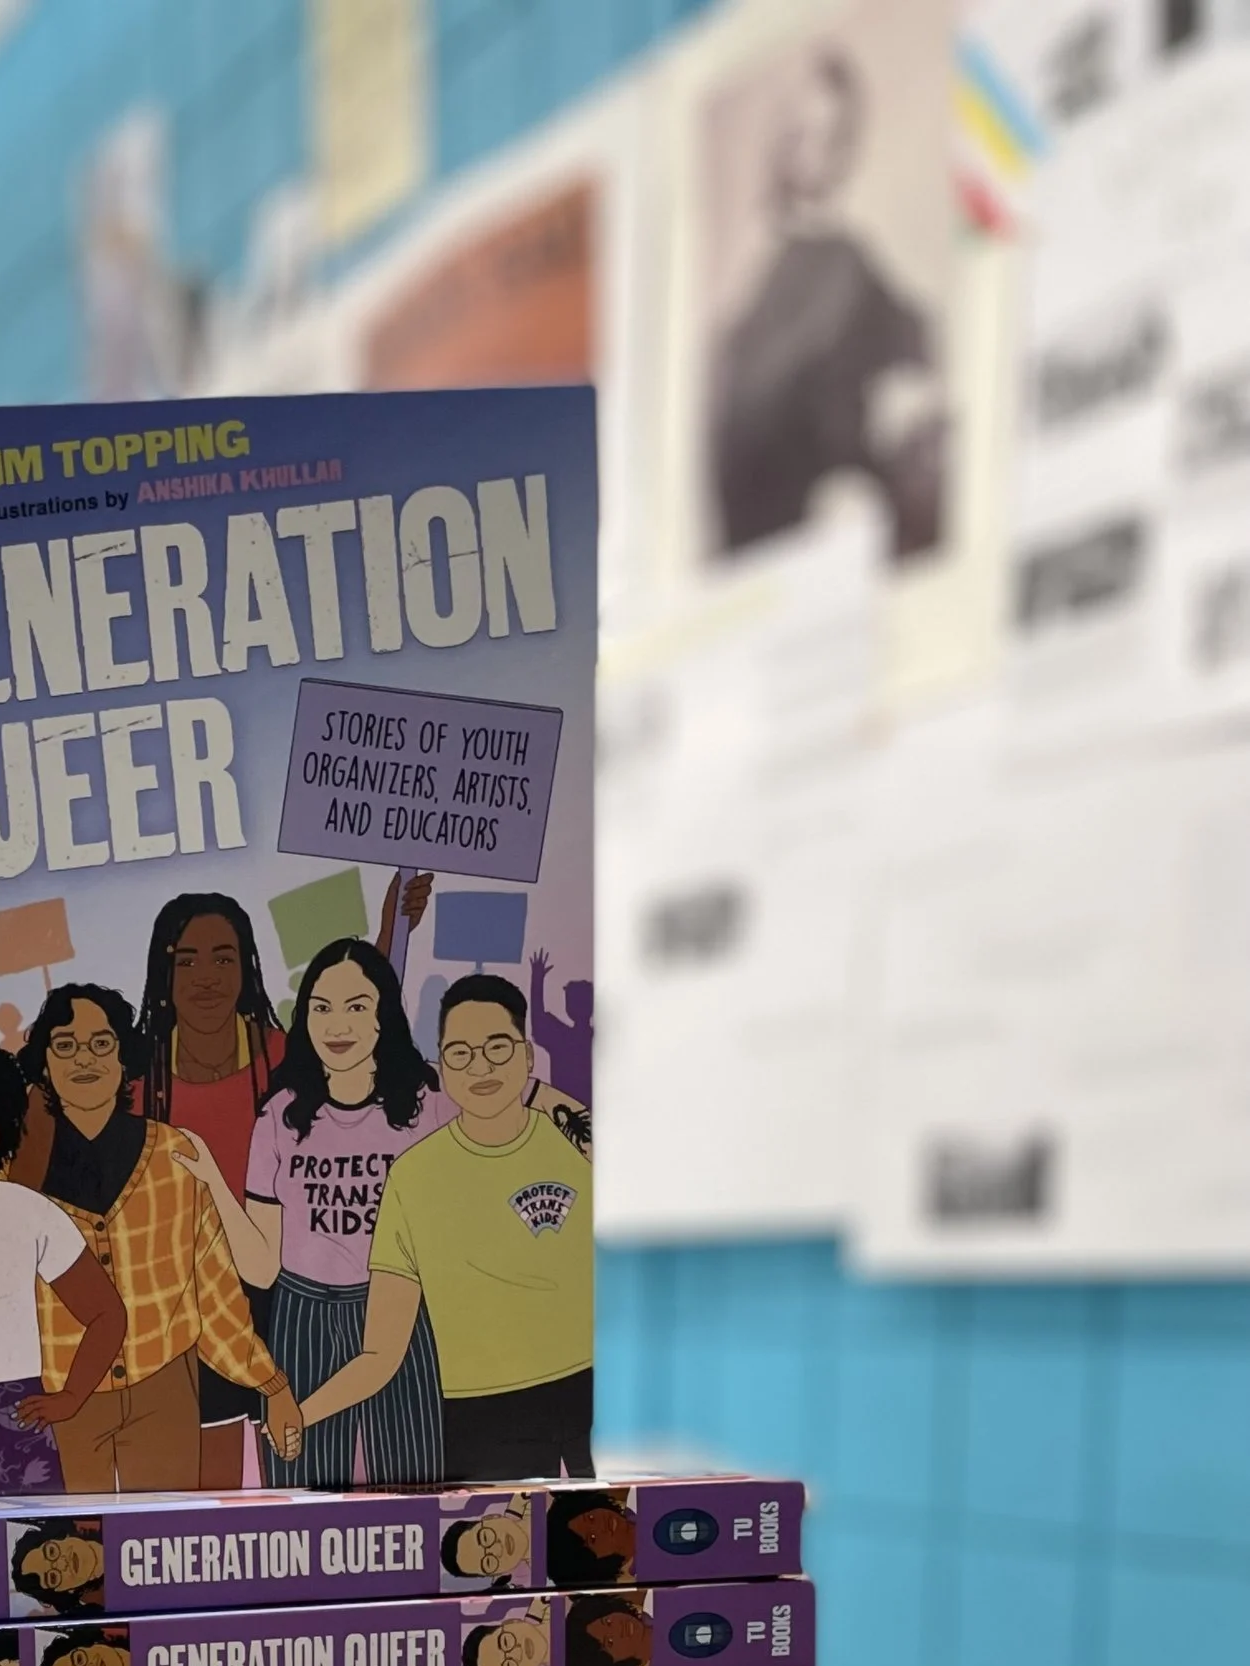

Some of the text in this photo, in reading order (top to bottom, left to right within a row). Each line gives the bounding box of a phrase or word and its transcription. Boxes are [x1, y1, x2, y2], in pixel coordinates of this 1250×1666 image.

[62, 420, 250, 475] TOPPING
[104, 489, 129, 512] by
[138, 471, 235, 504] ANSHIKA
[240, 459, 343, 492] KHULLAR
[321, 710, 531, 765] STORIES OF YOUTH
[303, 752, 533, 815] ORGANIZERS, ARTISTS,
[325, 798, 498, 852] AND EDUCATORS
[290, 1154, 394, 1178] PROTECT
[304, 1183, 382, 1207] TRANS
[514, 1185, 570, 1207] PROTECT
[522, 1200, 563, 1215] TRANS
[311, 1207, 376, 1235] KIDS
[531, 1213, 558, 1228] KIDS
[733, 1517, 753, 1541] TU
[759, 1501, 779, 1554] BOOKS
[120, 1524, 424, 1587] GENERATION QUEER
[747, 1621, 766, 1643] TU
[771, 1604, 791, 1657] BOOKS
